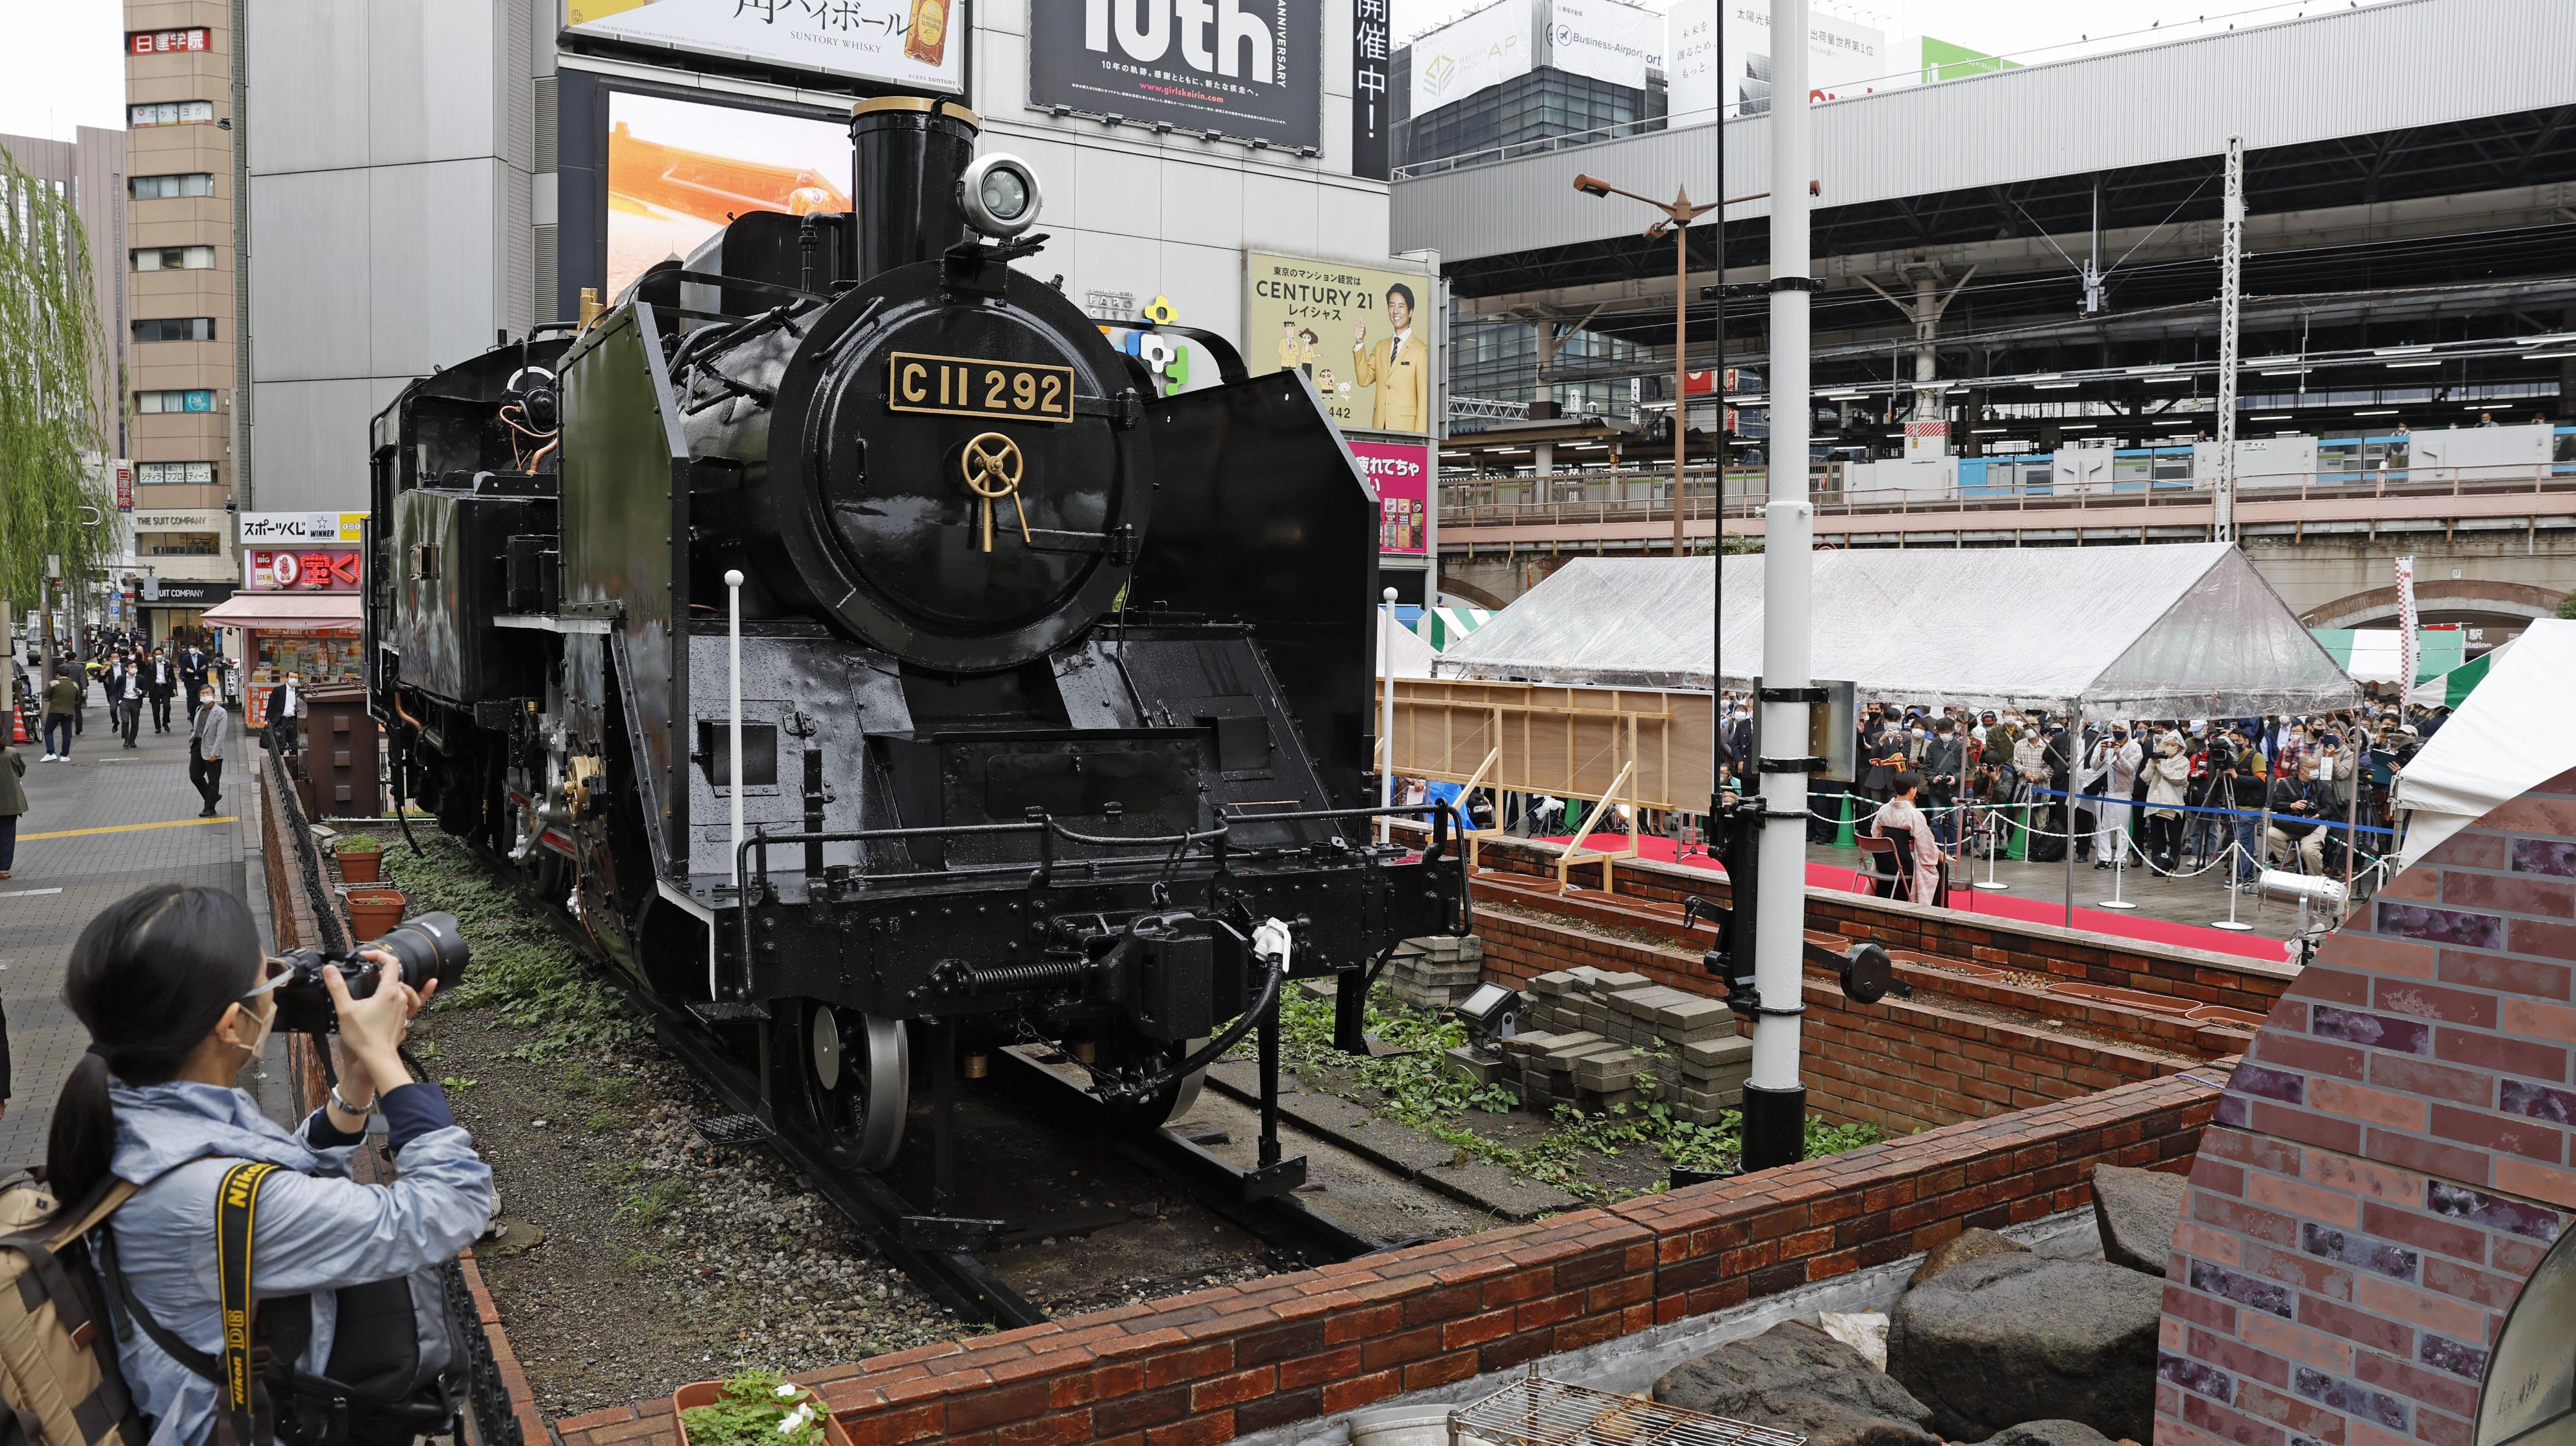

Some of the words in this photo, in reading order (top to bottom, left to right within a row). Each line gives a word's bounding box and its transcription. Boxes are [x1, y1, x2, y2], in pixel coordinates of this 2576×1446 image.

[136, 30, 203, 52] 日建学院
[790, 31, 839, 46] SUNTORY
[843, 39, 882, 53] WHISKY
[1277, 0, 1287, 88] ANNIVERSARY
[1573, 32, 1642, 58] Business-Airport
[928, 76, 956, 86] SUNTORY
[1139, 82, 1224, 104] www.girlskeirin.com
[149, 106, 202, 118] ホットヨガ
[1273, 266, 1361, 286] 東京のマンション経営は
[1256, 280, 1351, 306] CENTURY
[1357, 292, 1372, 310] 21
[1289, 304, 1342, 321] レイシャス
[985, 370, 1062, 412] 292
[118, 471, 130, 506] 日建学院
[137, 517, 151, 525] THE
[153, 517, 169, 525] SUIT
[170, 517, 206, 525] COMPANY
[244, 519, 305, 536] スポーツくじ
[2469, 629, 2483, 640] 駅
[233, 1356, 244, 1405] Nikon
